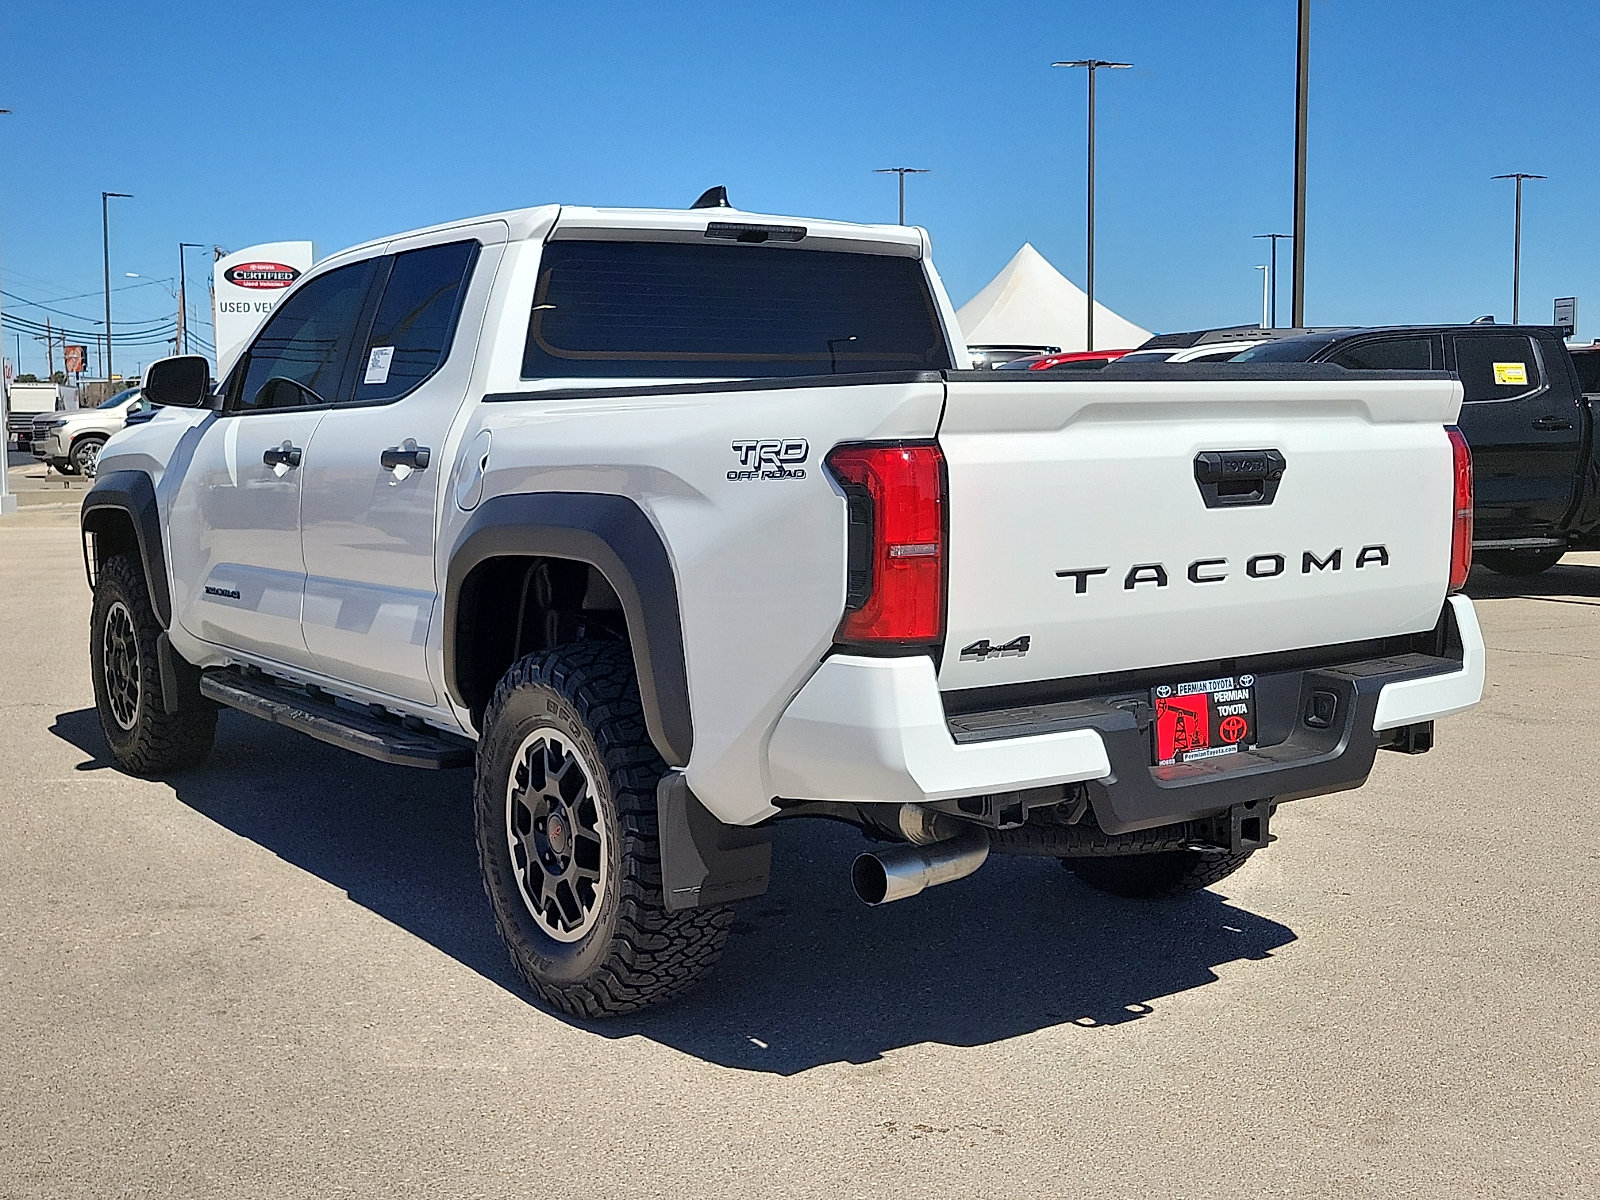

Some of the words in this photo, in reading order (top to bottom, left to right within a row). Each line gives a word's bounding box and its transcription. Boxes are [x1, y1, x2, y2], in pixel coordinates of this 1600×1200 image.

[233, 270, 294, 280] CERTIFIED
[220, 302, 251, 313] USED
[731, 438, 809, 471] TRD
[726, 470, 760, 481] OFF
[761, 469, 807, 481] ROAD
[1055, 543, 1390, 594] TACOMA
[1179, 682, 1208, 695] PERMIAN
[1208, 678, 1233, 692] TOYOTA
[1214, 689, 1249, 703] PERMIAN
[1217, 703, 1248, 717] TOYOTA
